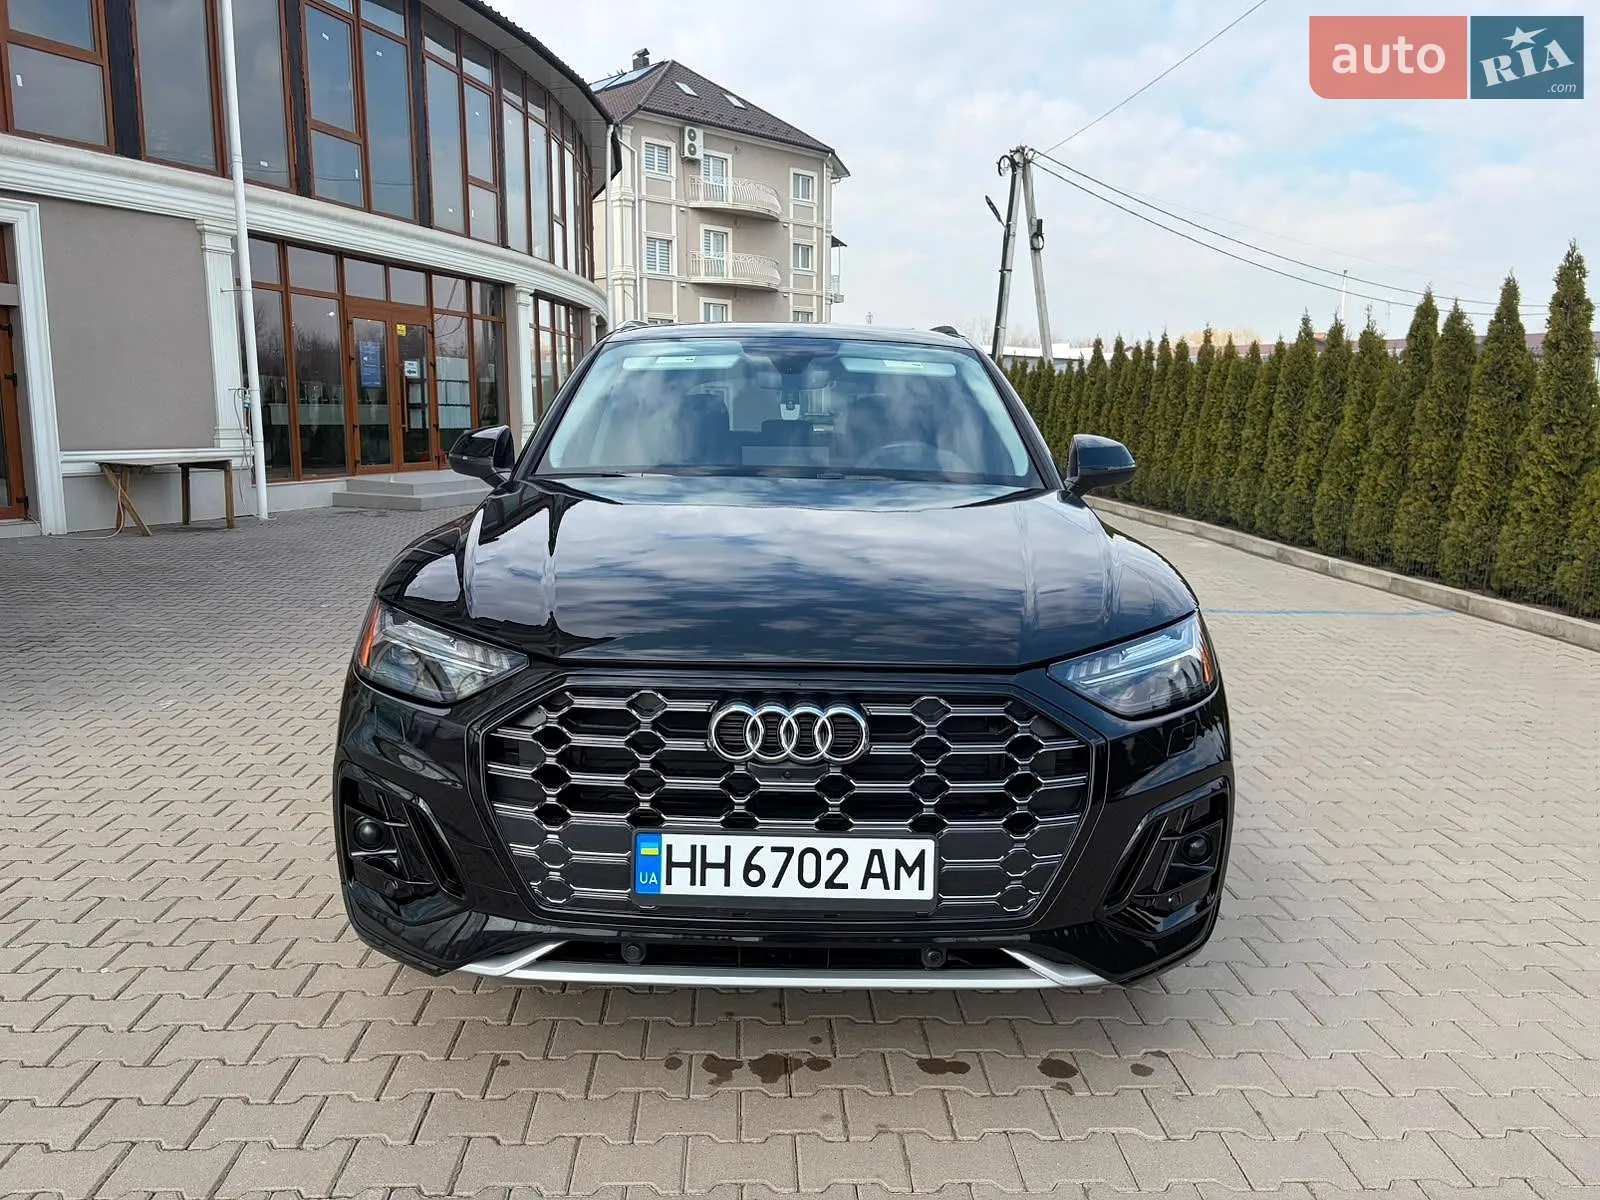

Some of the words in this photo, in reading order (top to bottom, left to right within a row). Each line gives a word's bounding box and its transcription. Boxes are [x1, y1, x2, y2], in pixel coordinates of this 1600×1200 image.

[639, 872, 658, 885] UA
[665, 844, 732, 887] HH
[742, 845, 849, 890] 6702
[860, 848, 926, 891] AM
